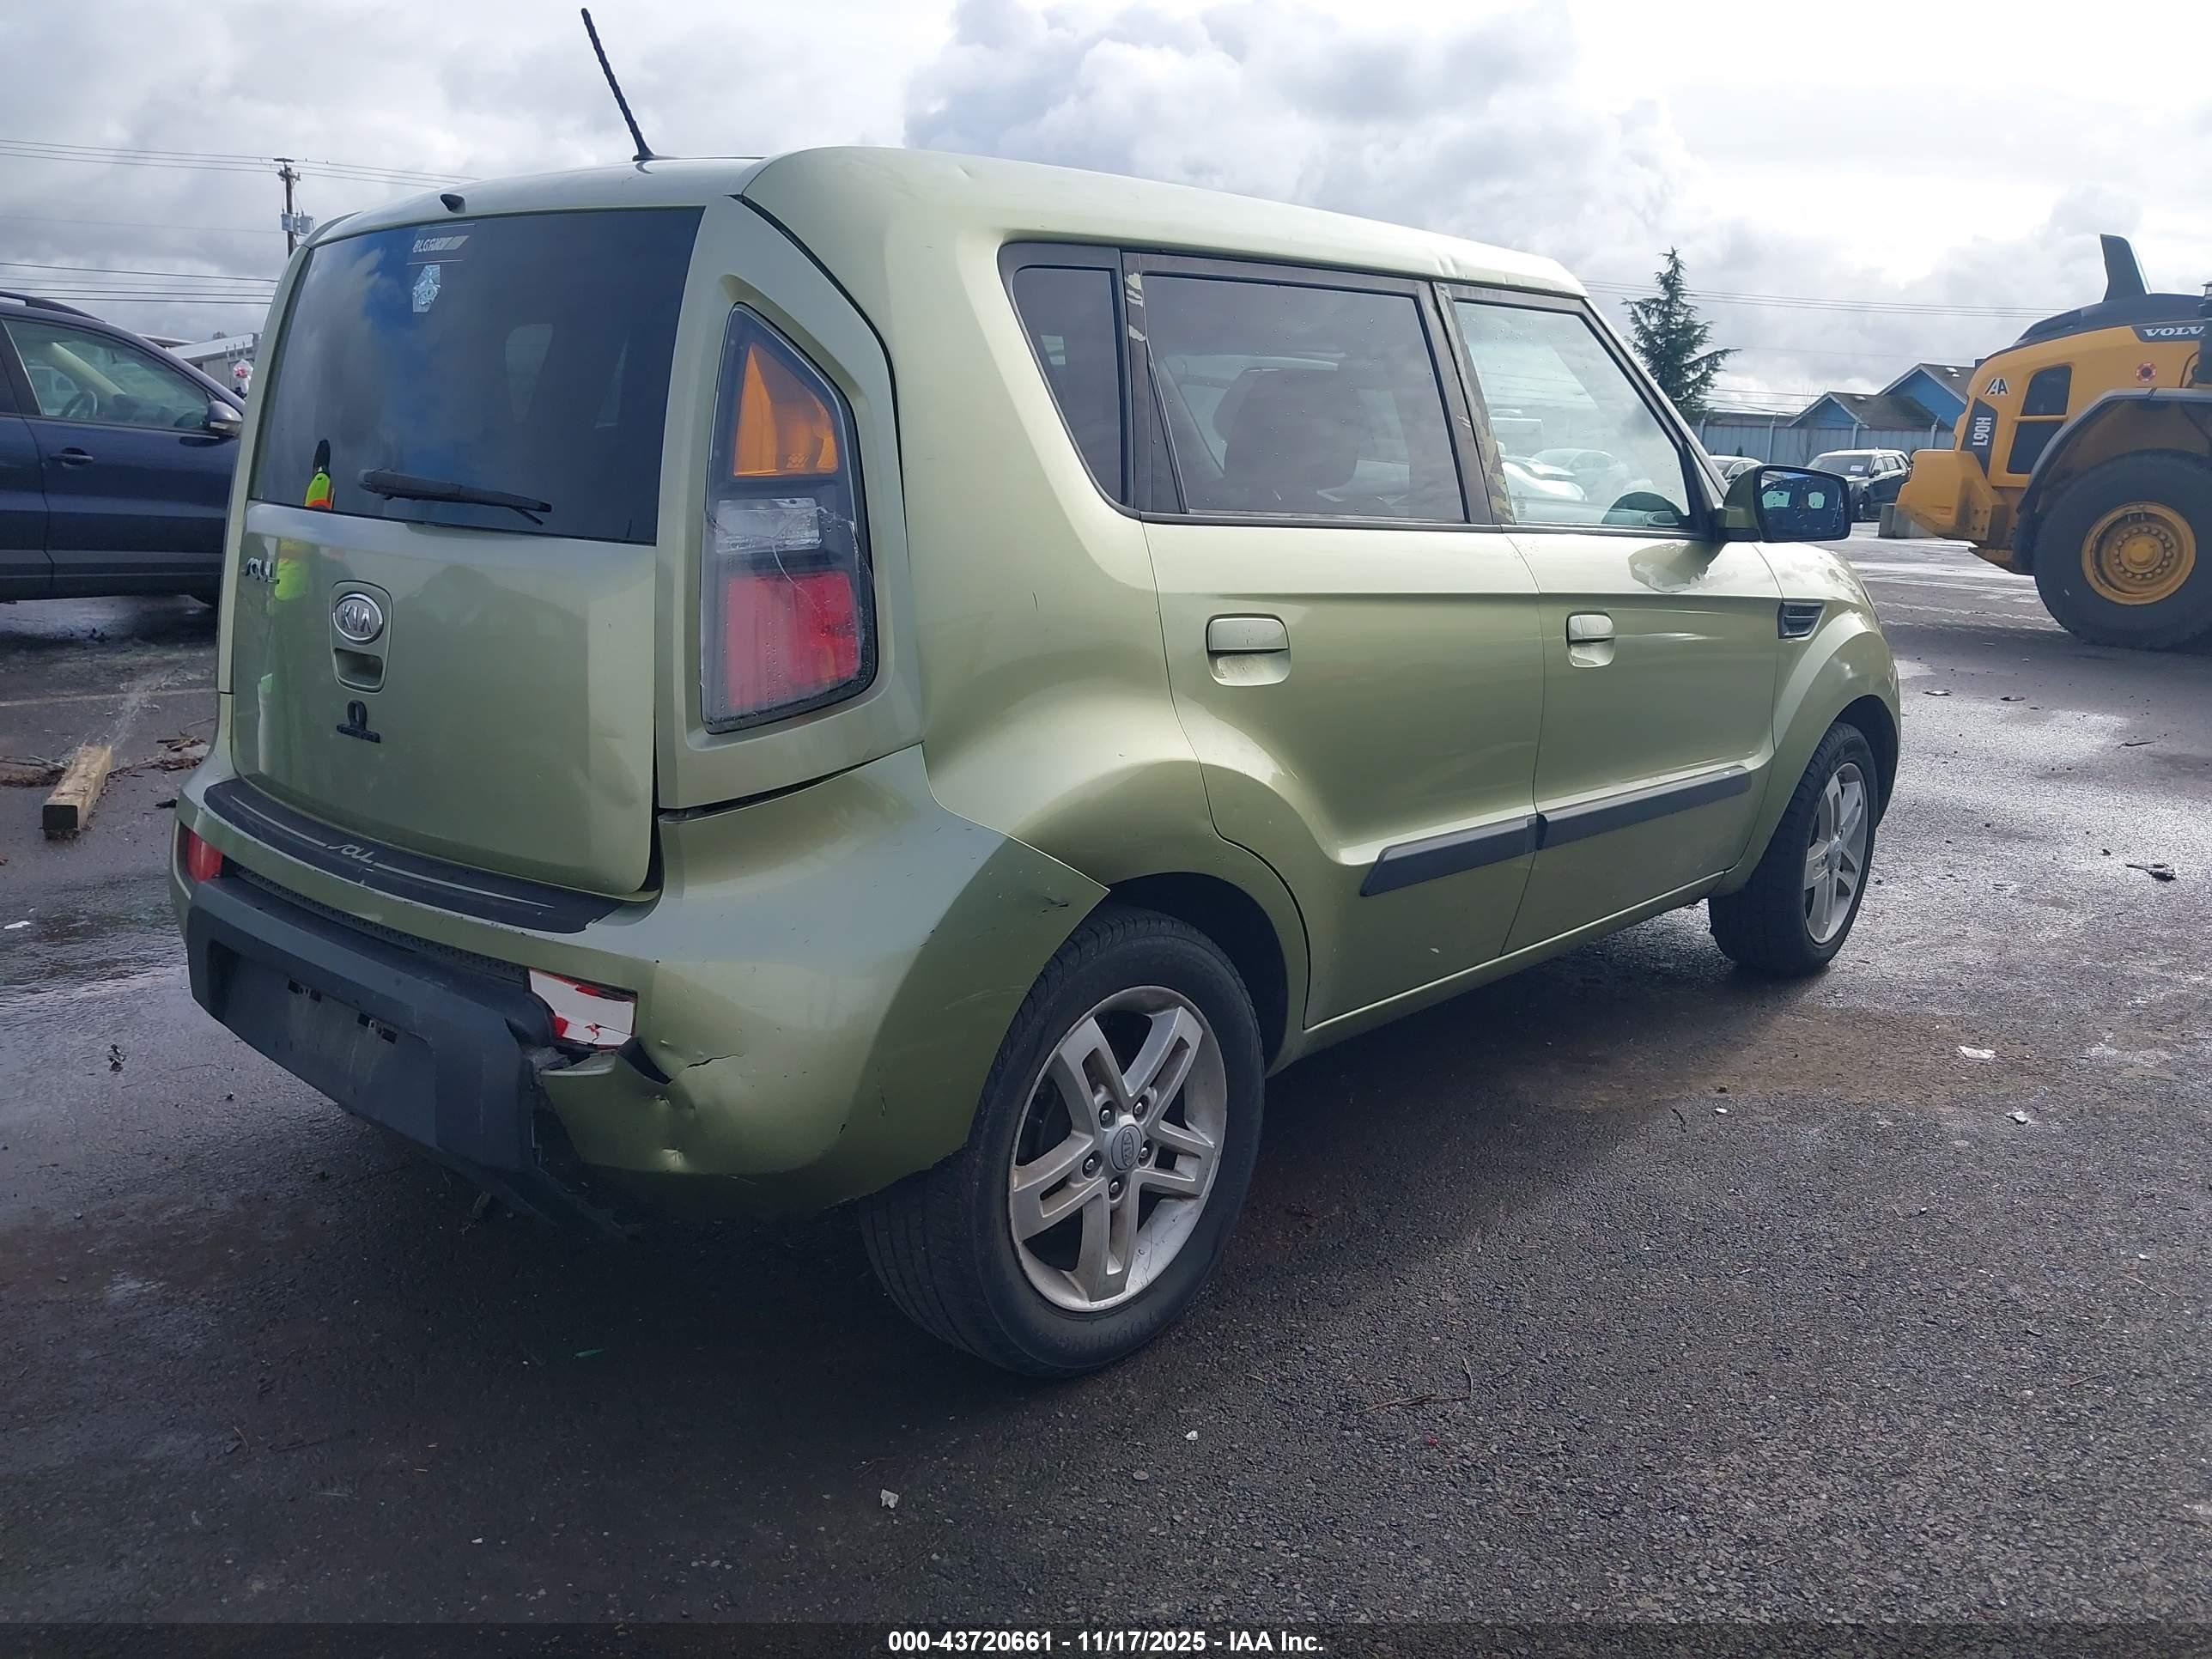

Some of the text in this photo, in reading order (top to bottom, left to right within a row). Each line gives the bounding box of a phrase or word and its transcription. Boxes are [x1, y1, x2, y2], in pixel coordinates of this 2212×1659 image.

[2143, 326, 2205, 337] VOLV
[1972, 417, 1992, 446] L90H
[340, 604, 373, 634] KIA
